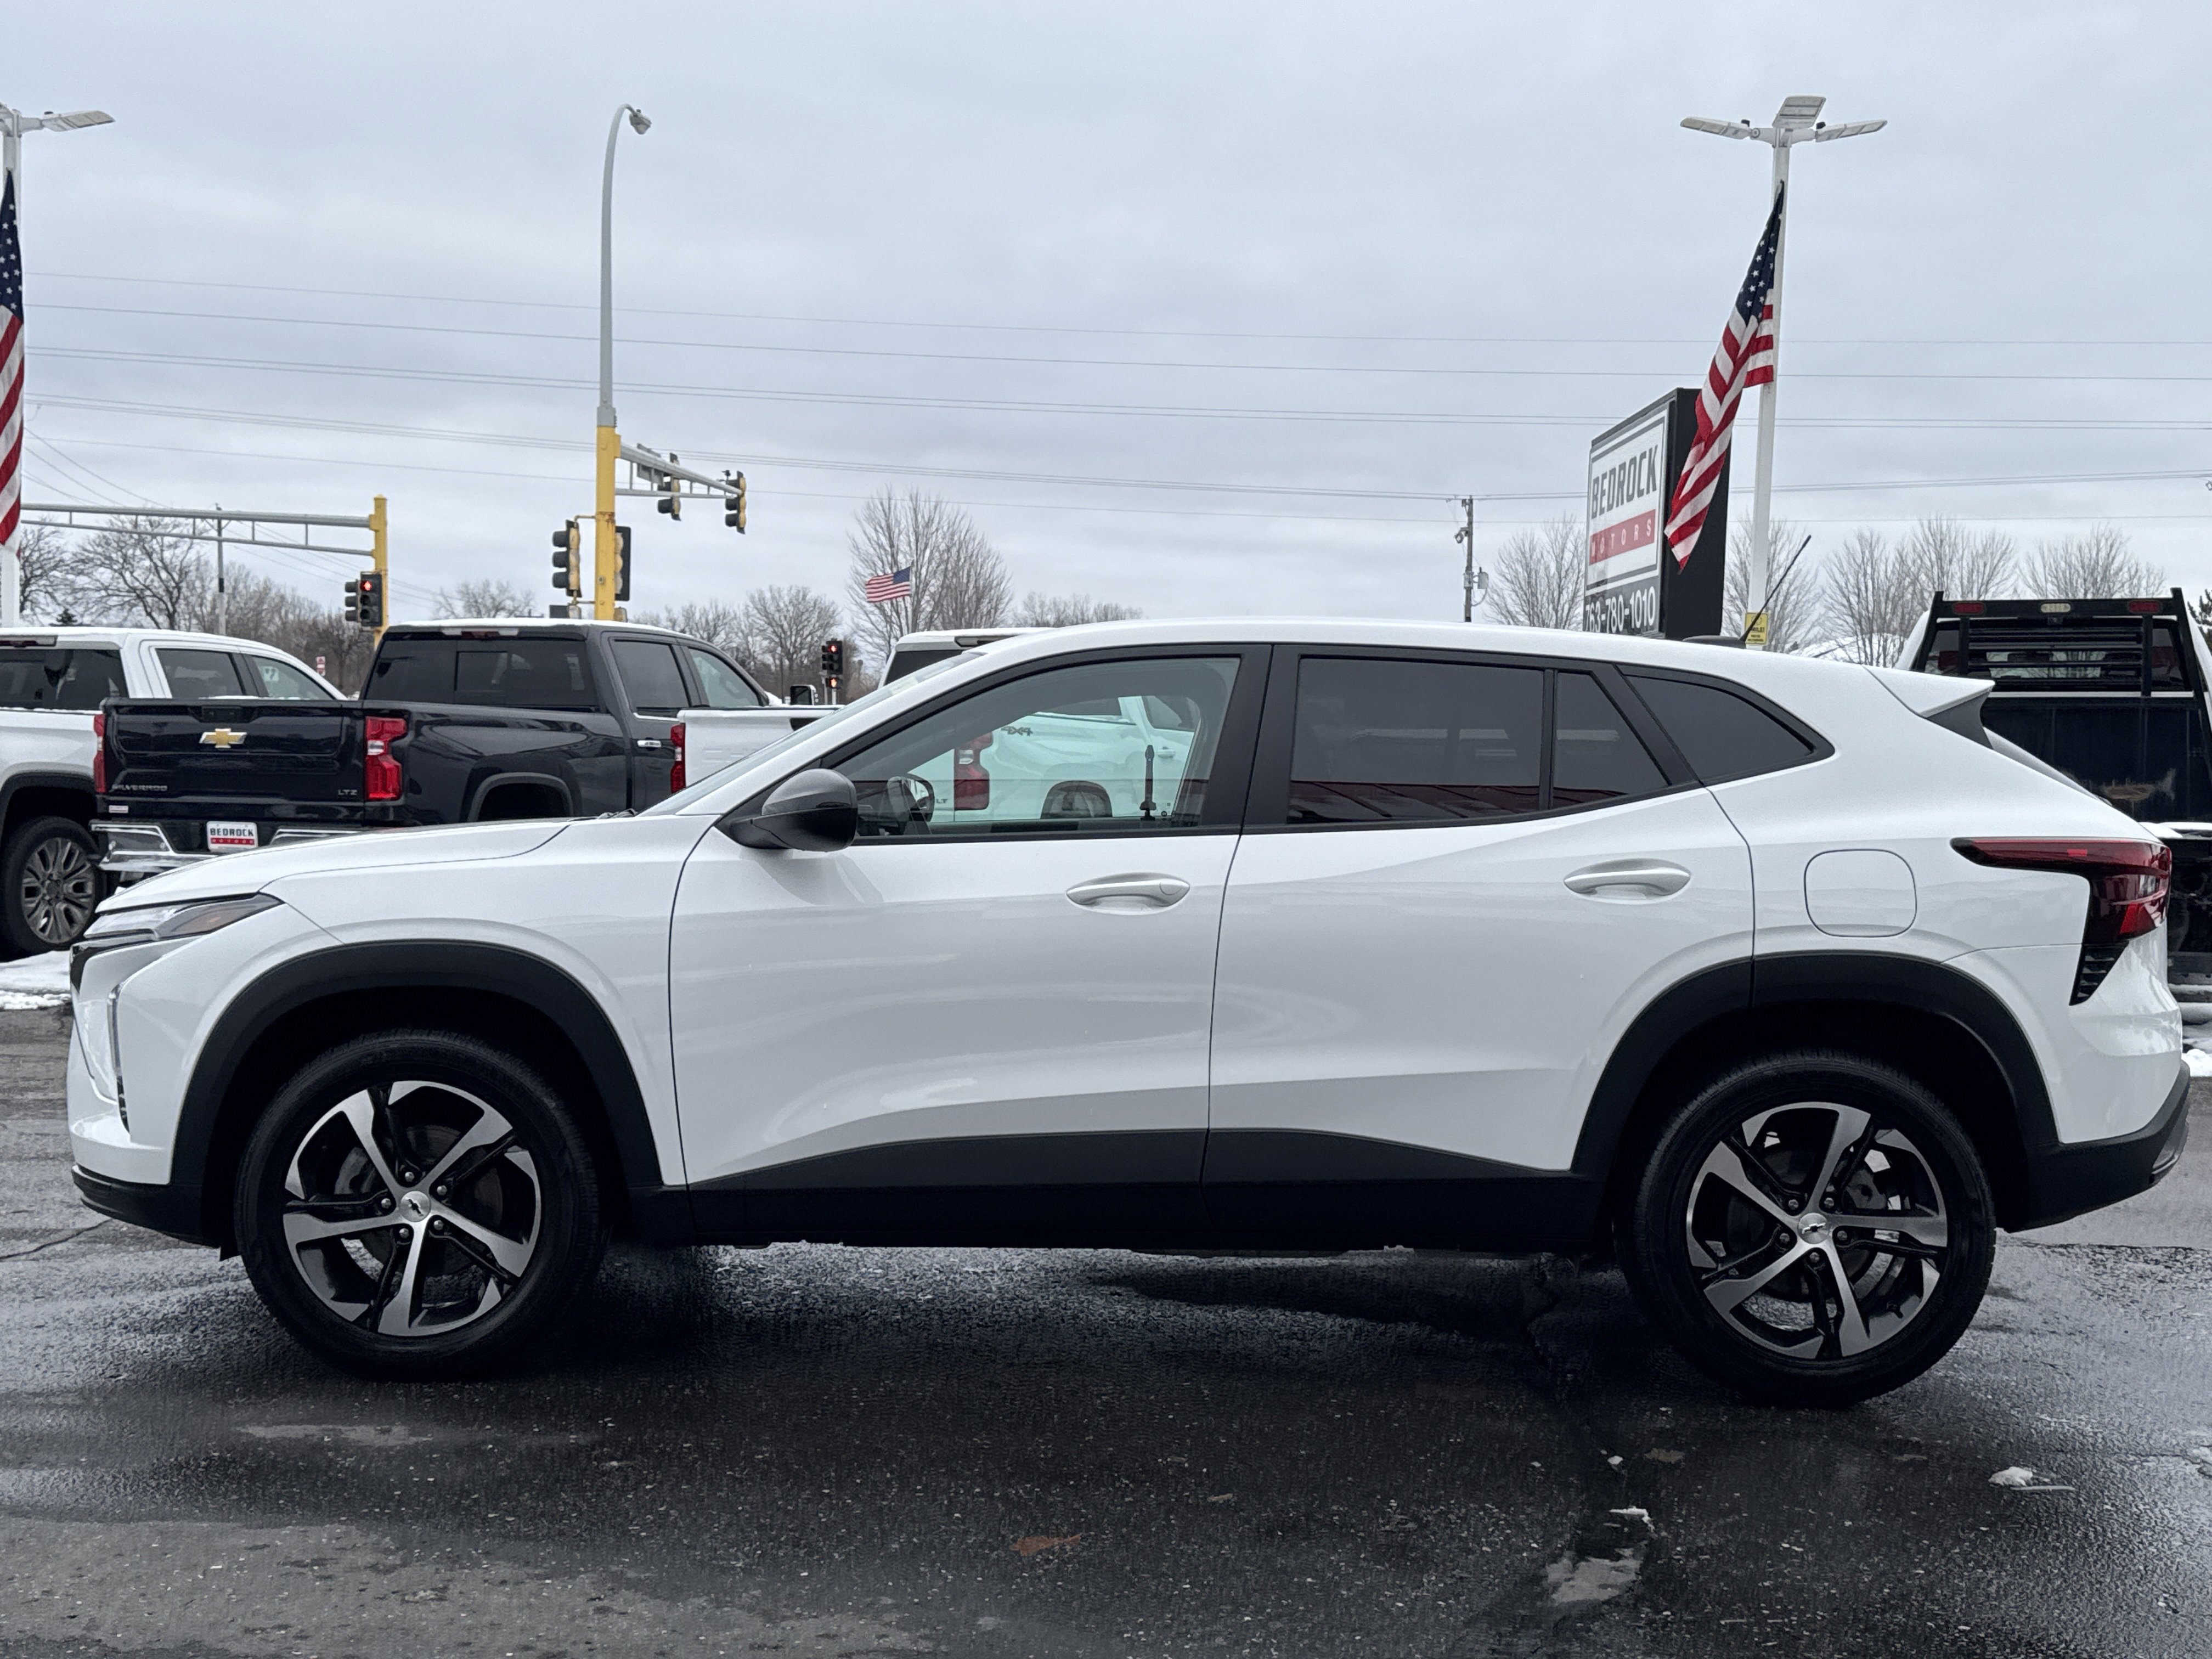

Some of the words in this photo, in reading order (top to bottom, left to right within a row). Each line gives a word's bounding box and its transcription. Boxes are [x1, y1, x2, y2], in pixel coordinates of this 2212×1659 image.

[1591, 444, 1658, 520] BEDROCK
[1585, 586, 1656, 634] 763-780-1010
[210, 828, 254, 837] BEDROCK
